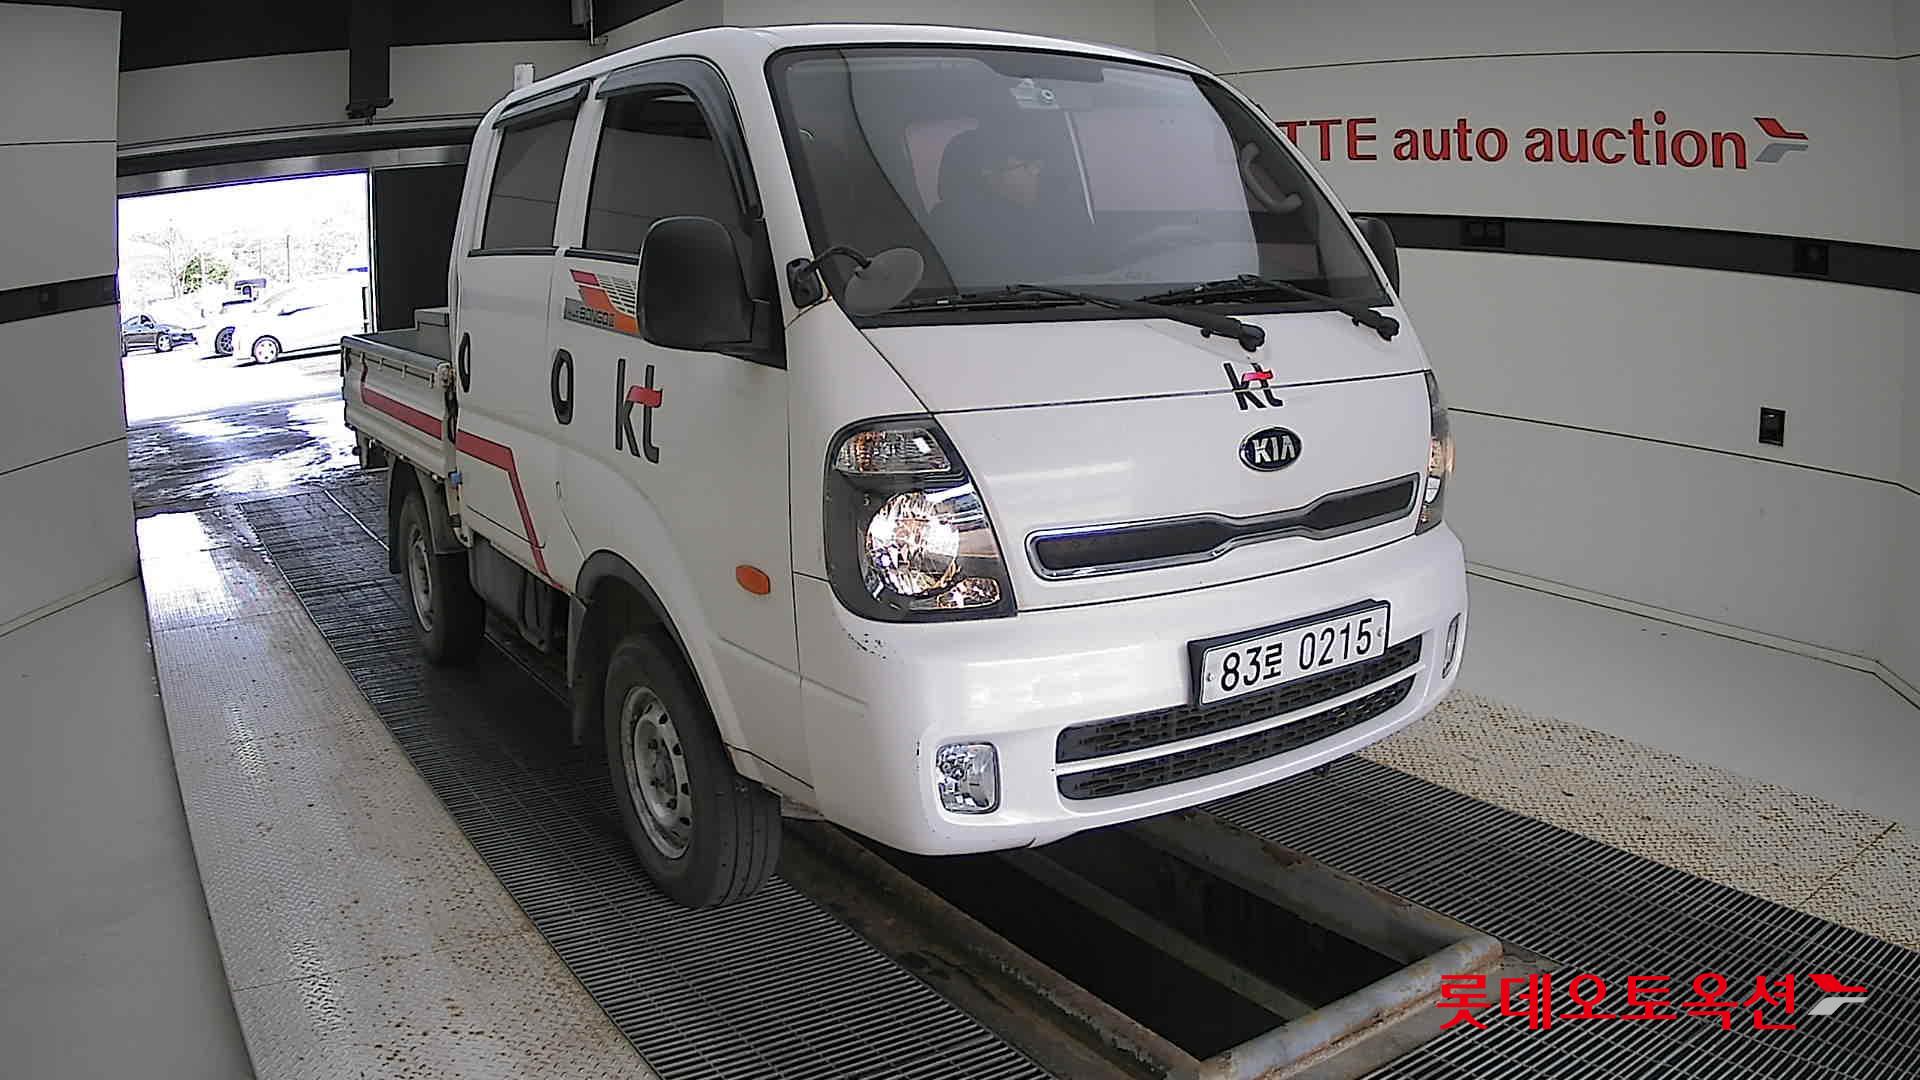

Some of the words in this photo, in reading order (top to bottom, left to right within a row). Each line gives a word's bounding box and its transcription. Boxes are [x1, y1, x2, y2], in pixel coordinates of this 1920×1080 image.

[1392, 120, 1509, 163] auto
[1524, 110, 1748, 170] auction
[615, 358, 663, 464] kt
[1223, 362, 1284, 411] kt
[1252, 435, 1296, 464] KIA
[1220, 642, 1283, 692] 83로
[1299, 617, 1373, 671] 0215
